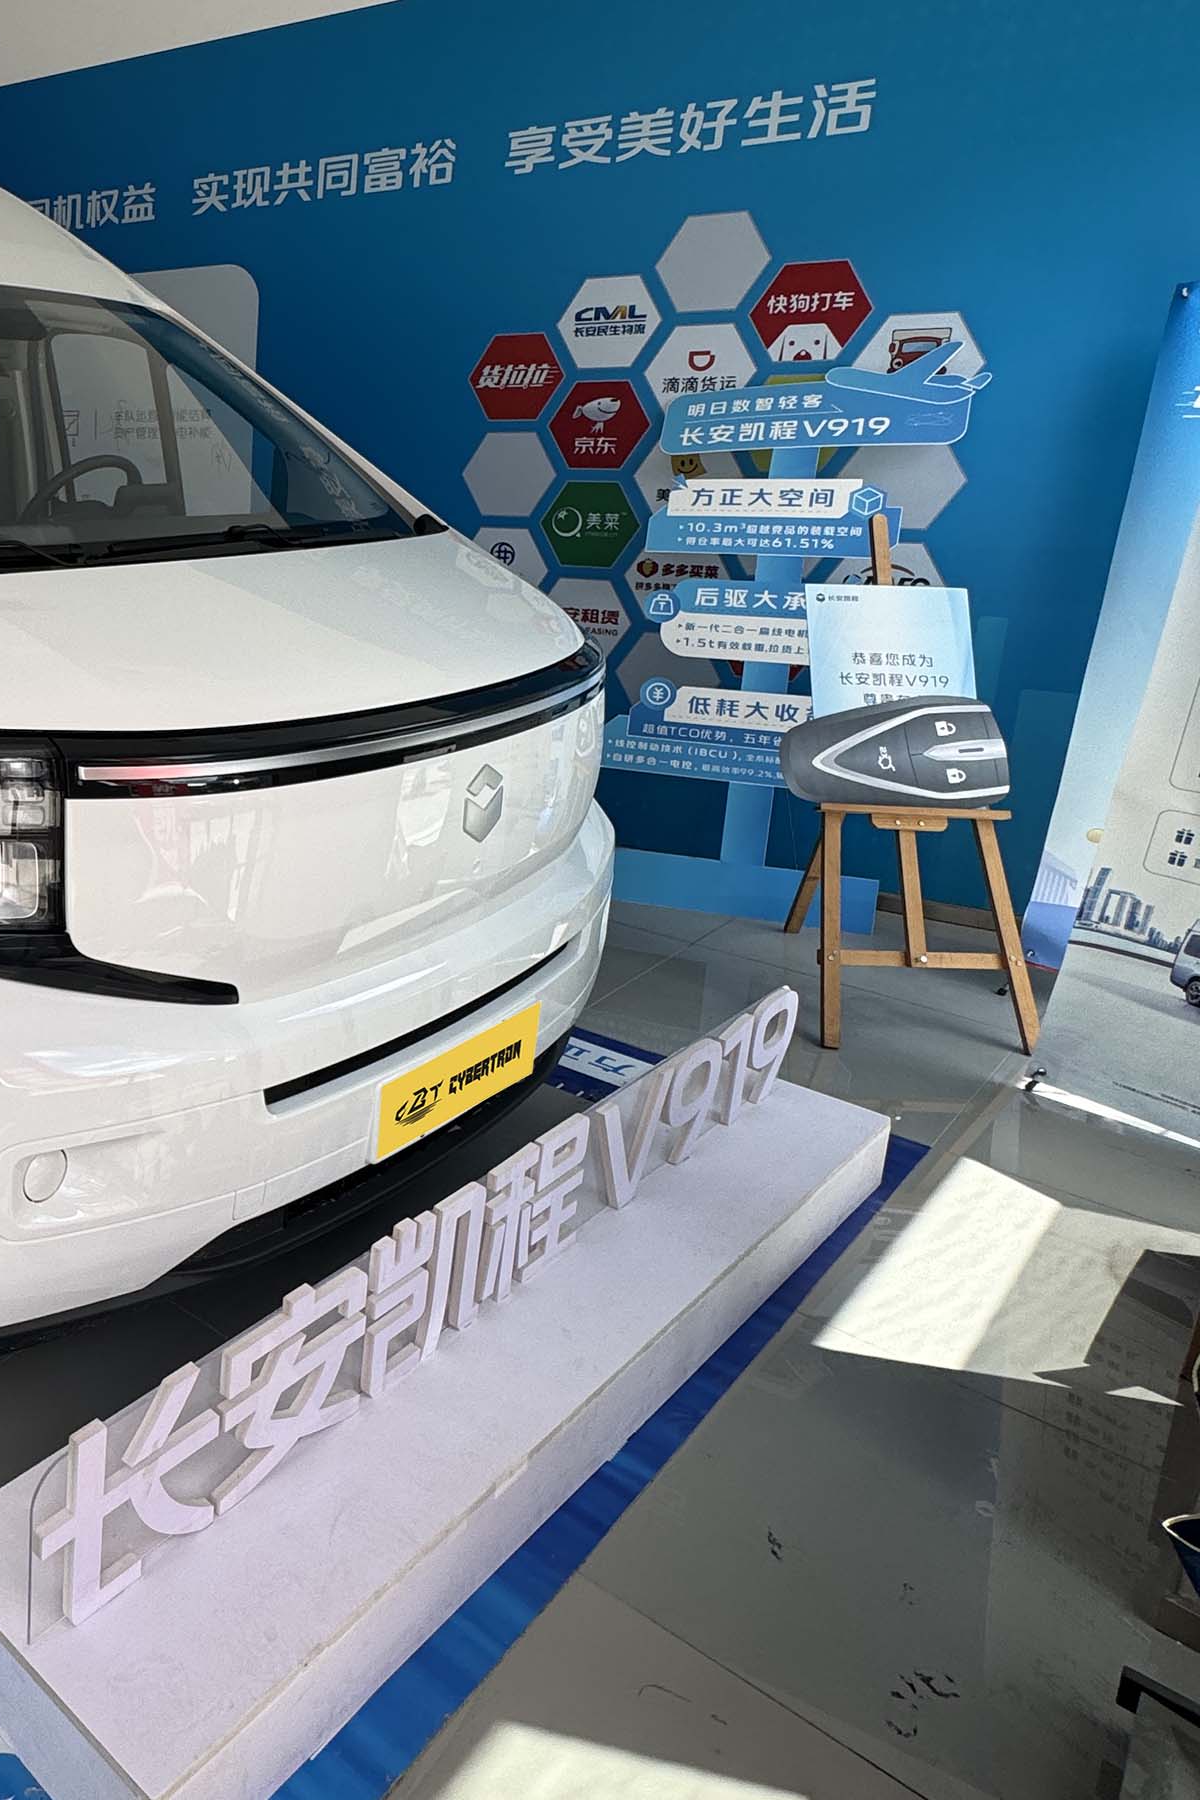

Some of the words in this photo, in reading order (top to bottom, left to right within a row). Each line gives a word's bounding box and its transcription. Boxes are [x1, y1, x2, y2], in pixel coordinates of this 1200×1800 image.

[191, 138, 457, 216] 实现共同富裕
[504, 77, 877, 176] 享受美好生活
[767, 291, 855, 314] 快狗打车
[476, 363, 552, 389] 货拉拉
[662, 375, 737, 393] 滴滴货运
[687, 394, 823, 417] 明日数智轻客
[680, 416, 891, 447] 长安凯程V919
[574, 437, 617, 454] 京东
[691, 487, 835, 508] 方正大空间
[585, 513, 620, 531] 美菜
[661, 563, 720, 579] 多多买菜
[851, 652, 934, 668] 恭喜您成为
[839, 672, 950, 688] 长安凯程V919
[448, 1039, 522, 1095] CYBERTRON
[34, 984, 799, 1626] 长安凯程V919
